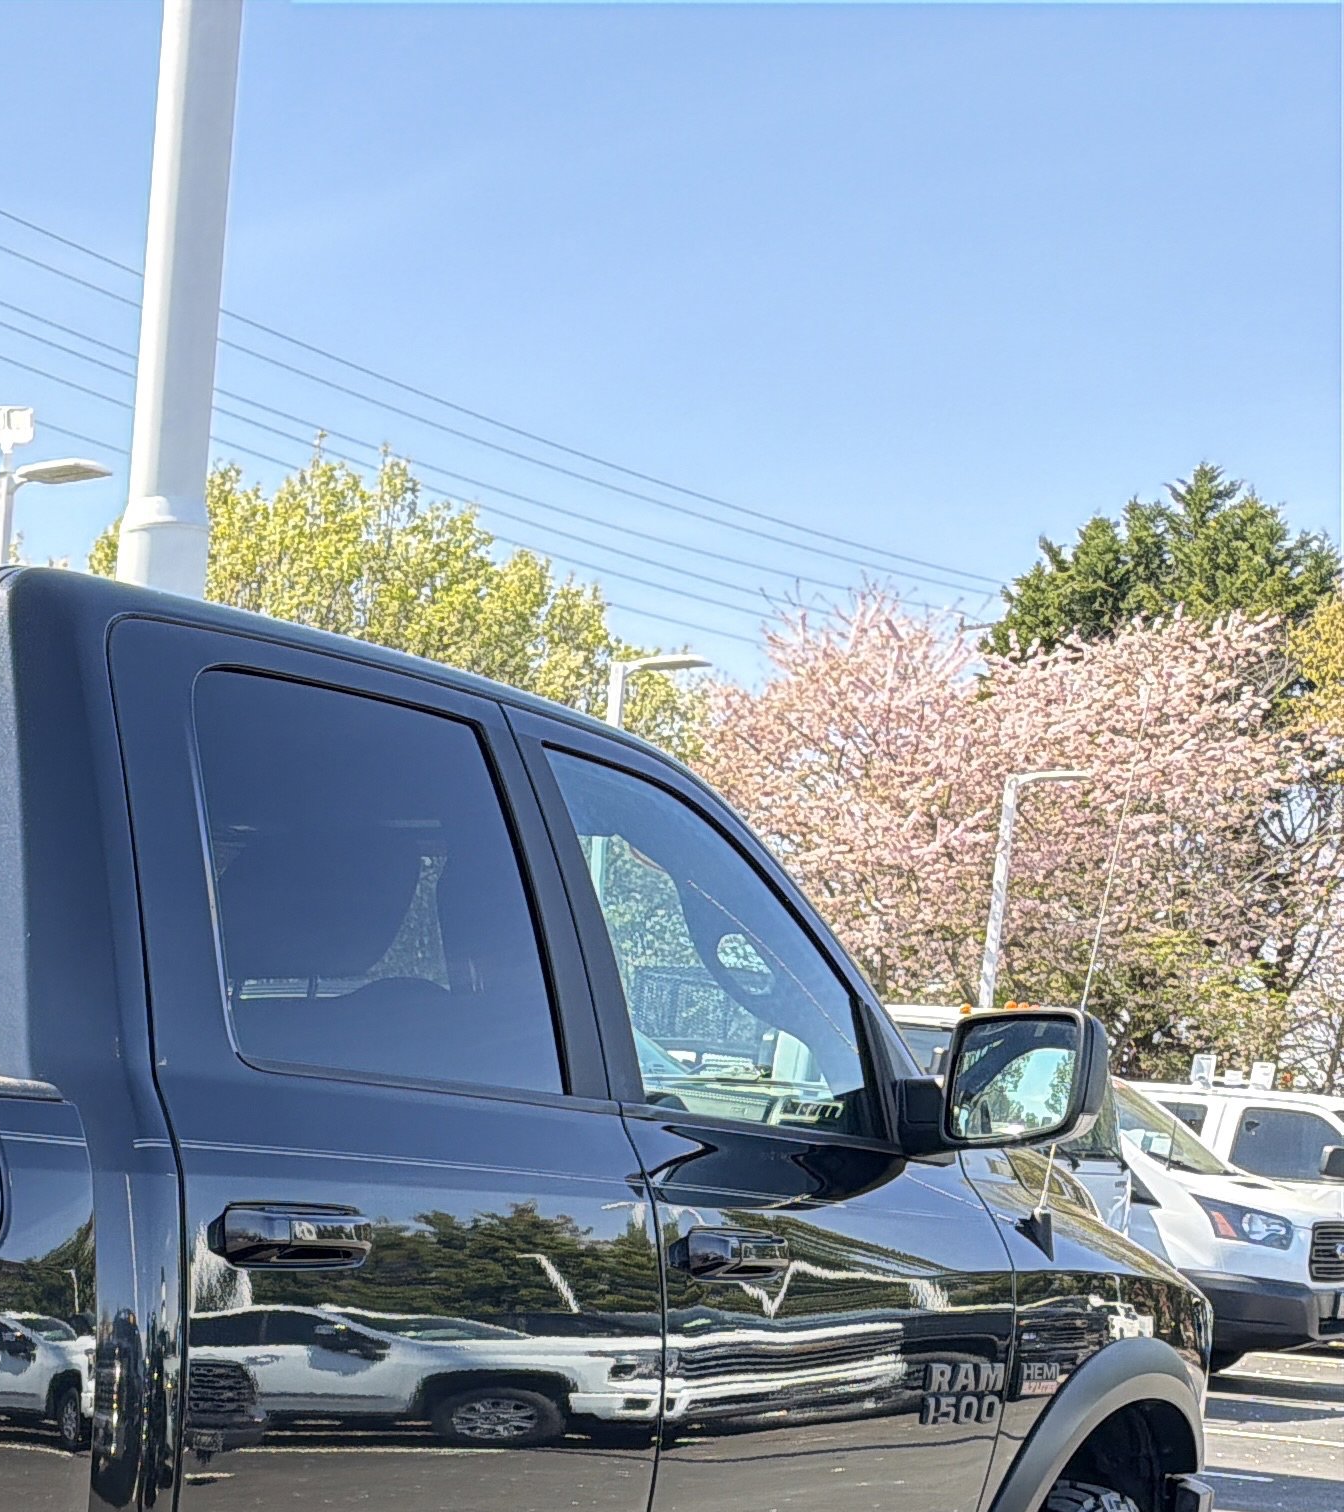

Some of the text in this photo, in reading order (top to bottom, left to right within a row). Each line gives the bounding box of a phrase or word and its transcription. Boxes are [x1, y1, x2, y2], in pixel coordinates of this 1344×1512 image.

[925, 1362, 1005, 1393] RAM
[1021, 1362, 1061, 1380] HEMI
[920, 1395, 1003, 1425] 1500
